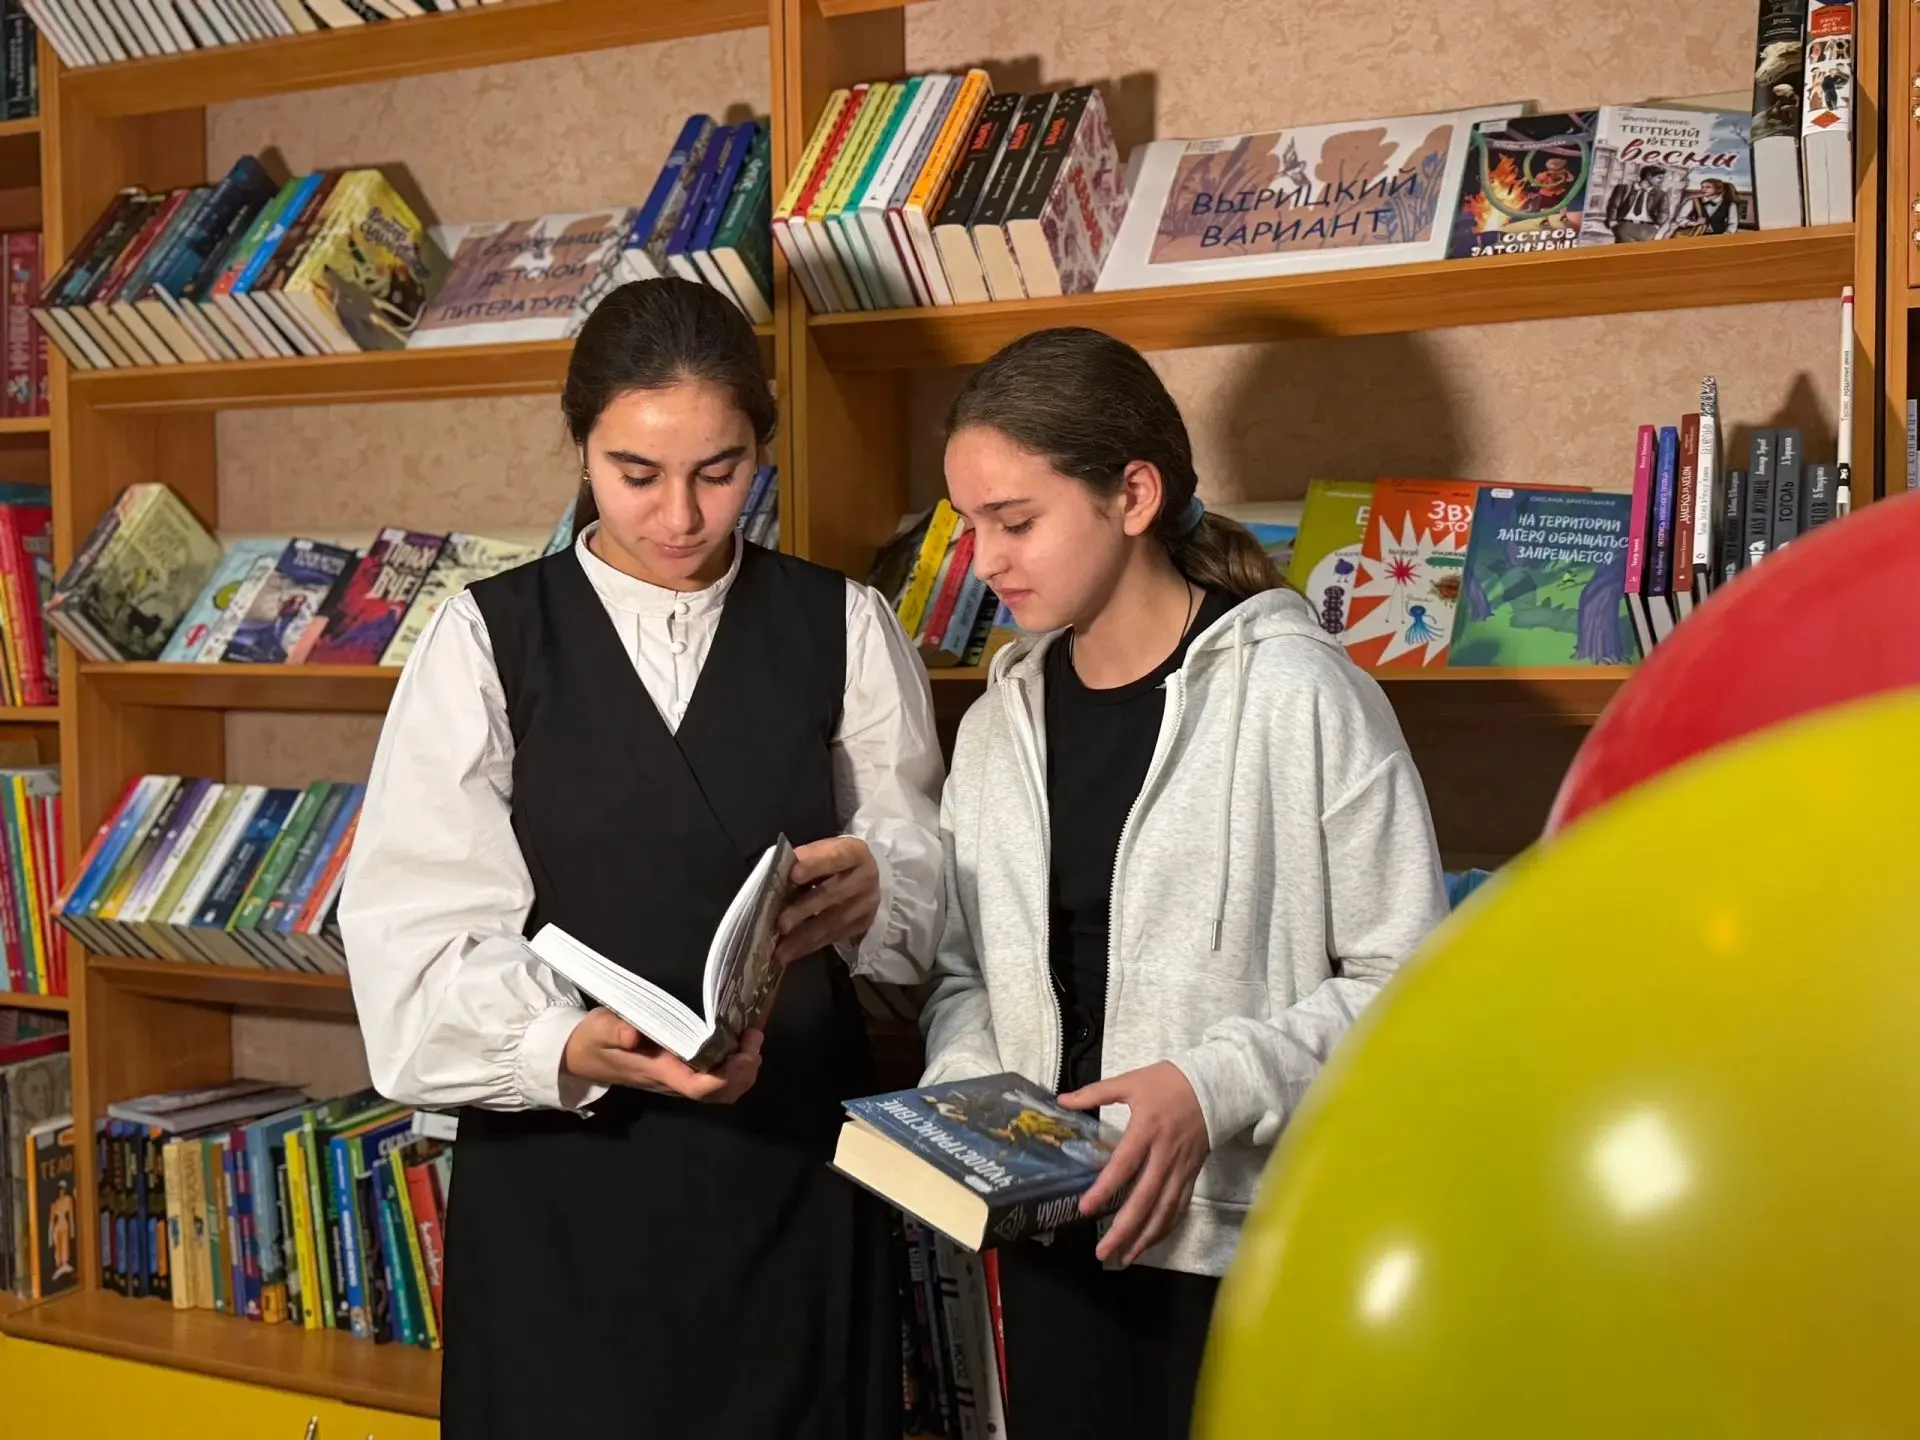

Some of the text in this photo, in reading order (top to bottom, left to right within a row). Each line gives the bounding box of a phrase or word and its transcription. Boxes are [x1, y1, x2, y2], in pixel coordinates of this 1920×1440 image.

[1620, 125, 1700, 138] ТЕРПКИЙ
[1646, 137, 1699, 148] ВЕТЕР
[1191, 166, 1418, 216] ВЫРИЦКИЙ
[1200, 208, 1393, 248] ВАРИАНТ
[1503, 228, 1576, 243] ОСТРОВ
[479, 263, 587, 288] ДЕТСКОЙ
[1779, 481, 1794, 522] ГОГОЛЬ
[1432, 521, 1468, 532] ЭТО
[1518, 513, 1621, 532] НА ТЕРРИТОРИИ
[1497, 528, 1629, 549] ЛАГЕРЯ ОБРАЩАТЬС
[1516, 546, 1615, 565] ЗАПРЕЩАЕТСЯ
